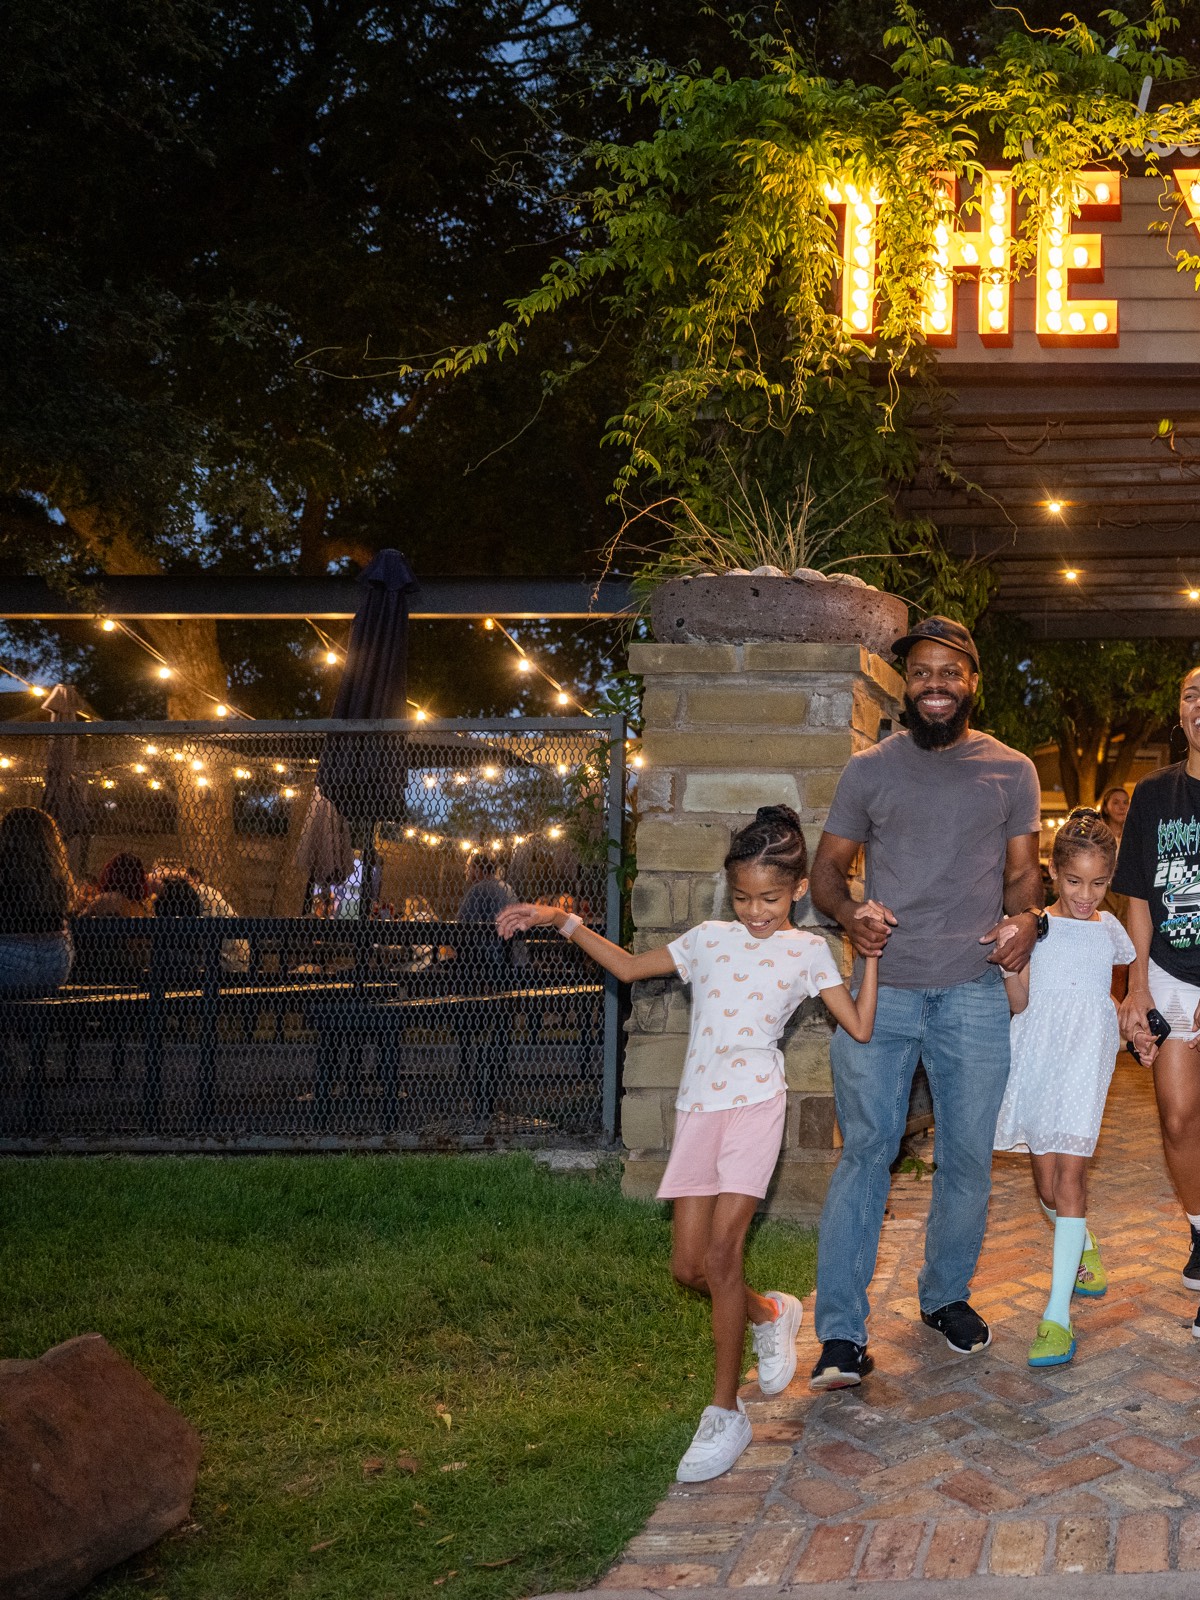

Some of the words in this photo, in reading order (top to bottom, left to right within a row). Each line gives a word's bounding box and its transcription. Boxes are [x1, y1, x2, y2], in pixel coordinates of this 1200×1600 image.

[822, 169, 1121, 348] THE
[1170, 850, 1196, 858] AFRAID
[1154, 858, 1186, 888] 26
